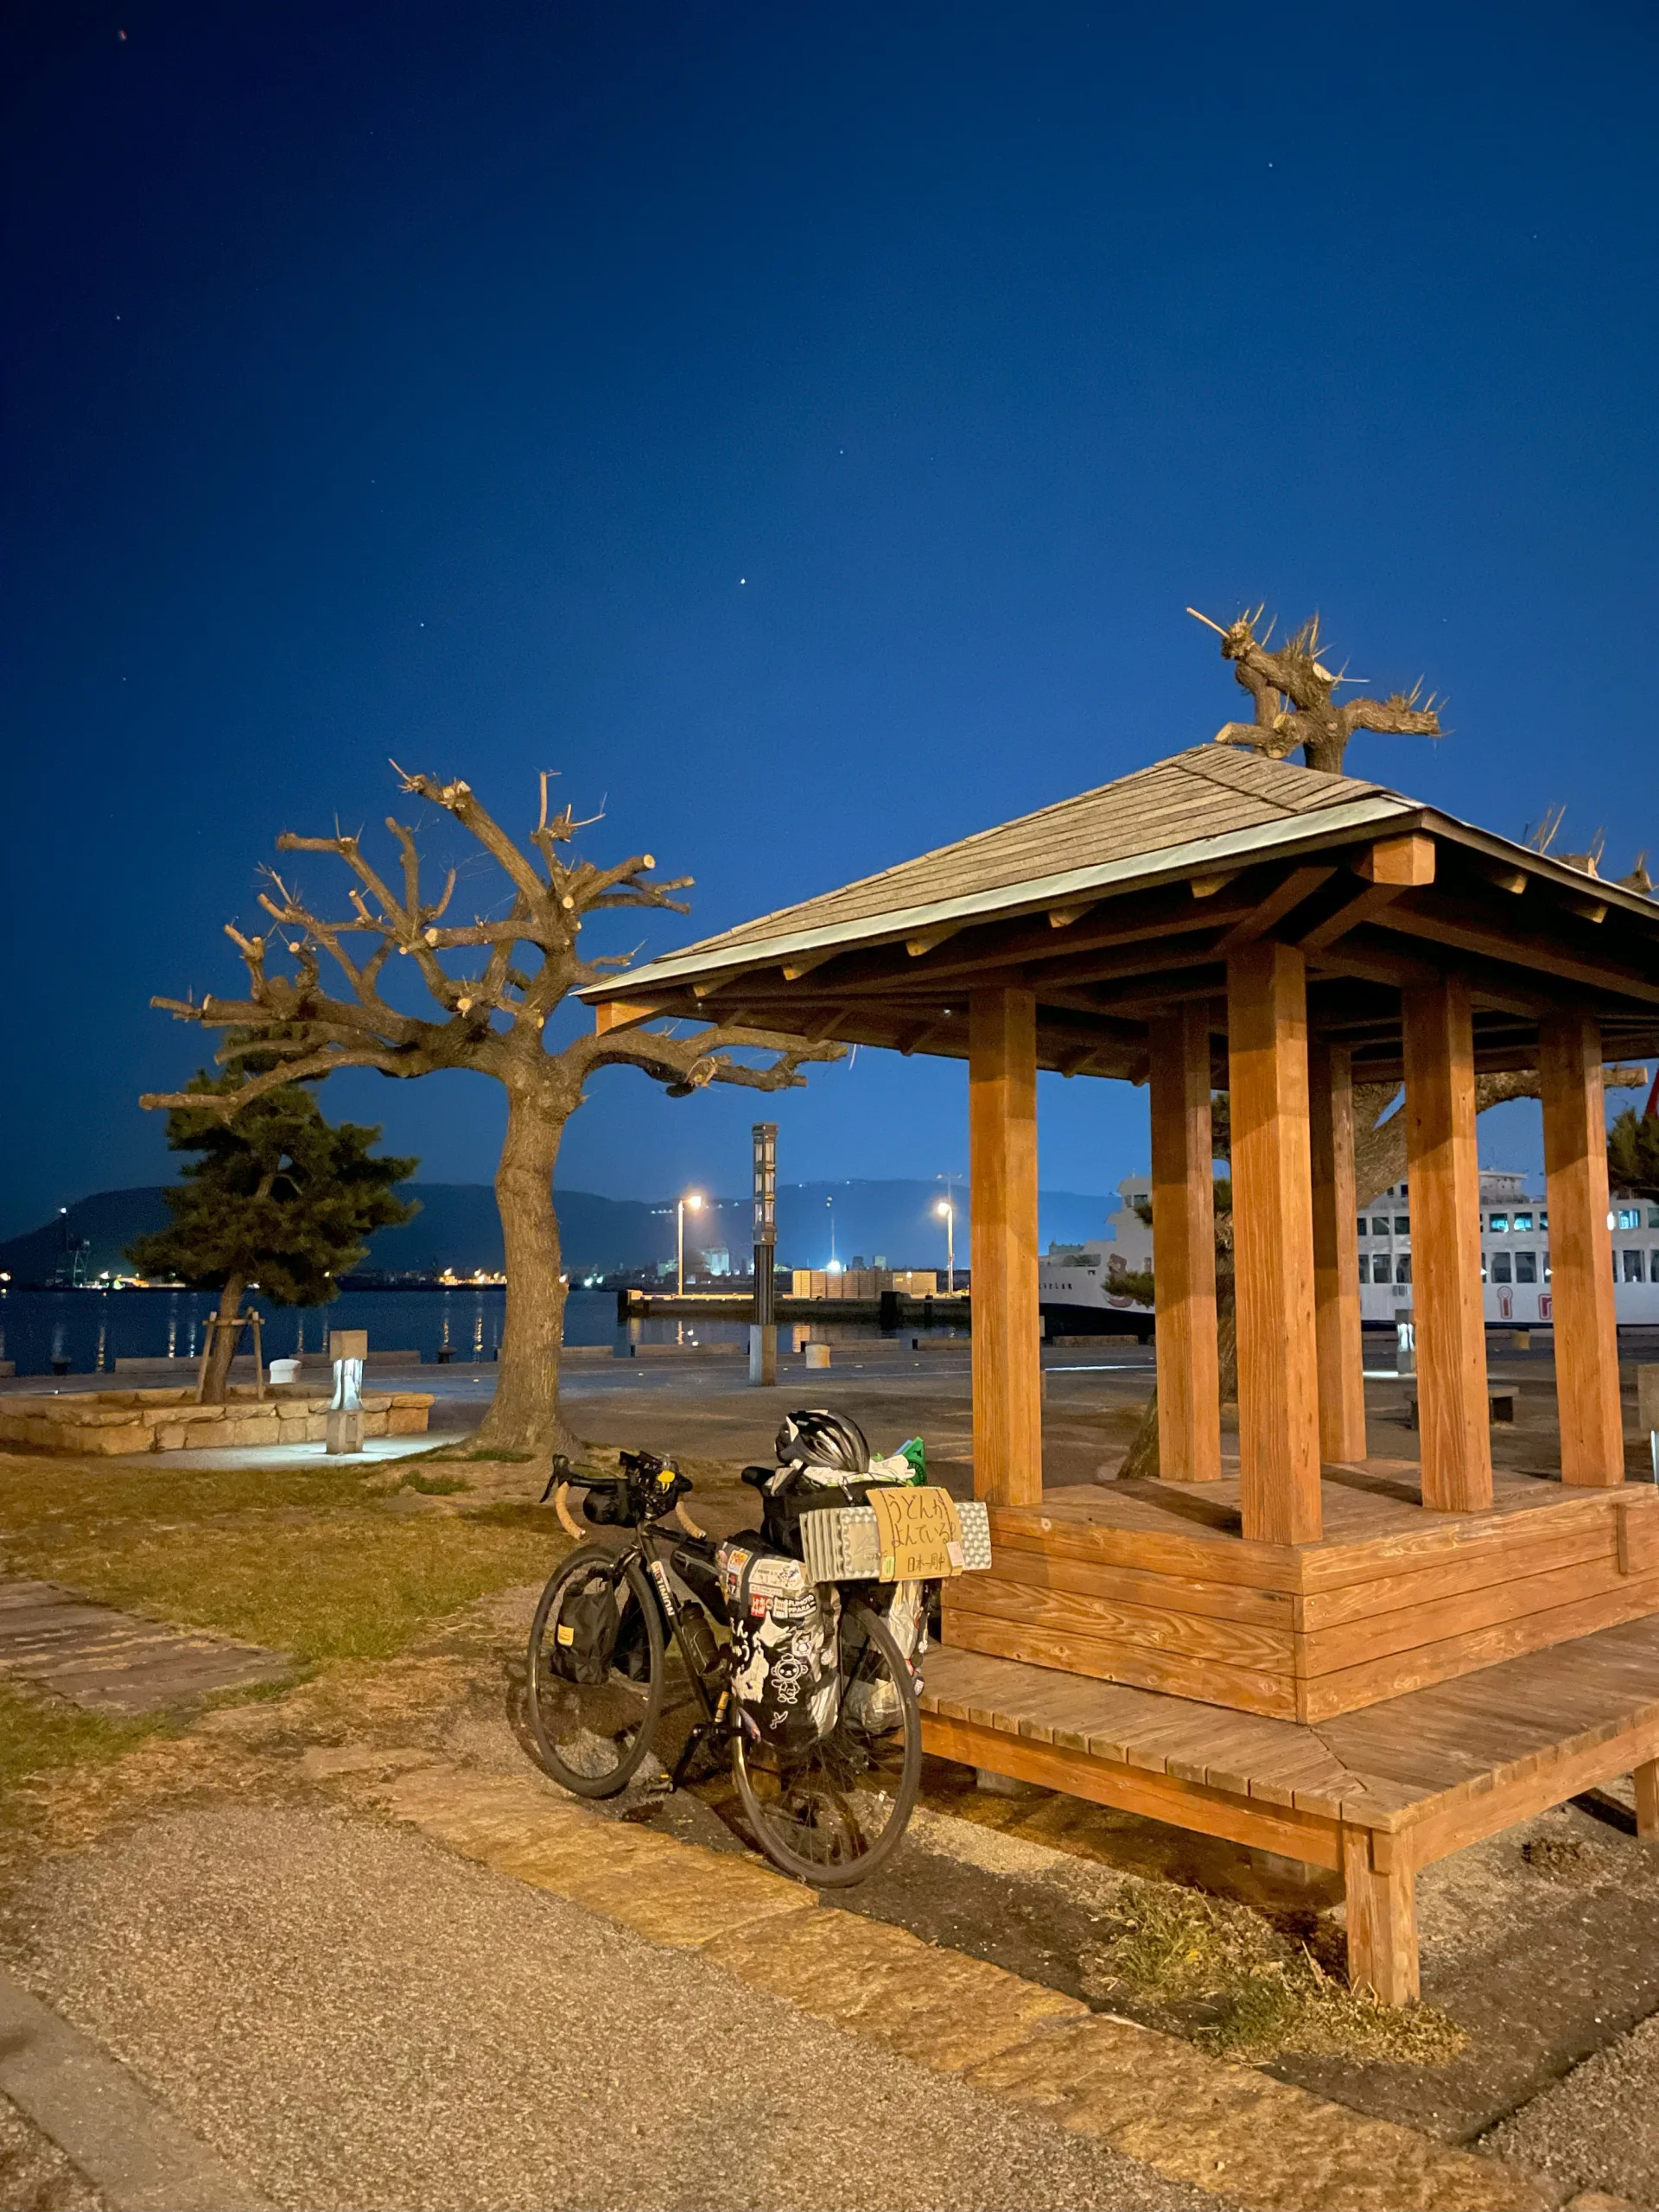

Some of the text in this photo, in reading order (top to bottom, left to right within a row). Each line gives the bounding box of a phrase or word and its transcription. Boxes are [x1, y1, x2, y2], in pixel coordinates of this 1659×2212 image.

[889, 1493, 948, 1524] うどんが
[907, 1552, 946, 1573] 日本一周中
